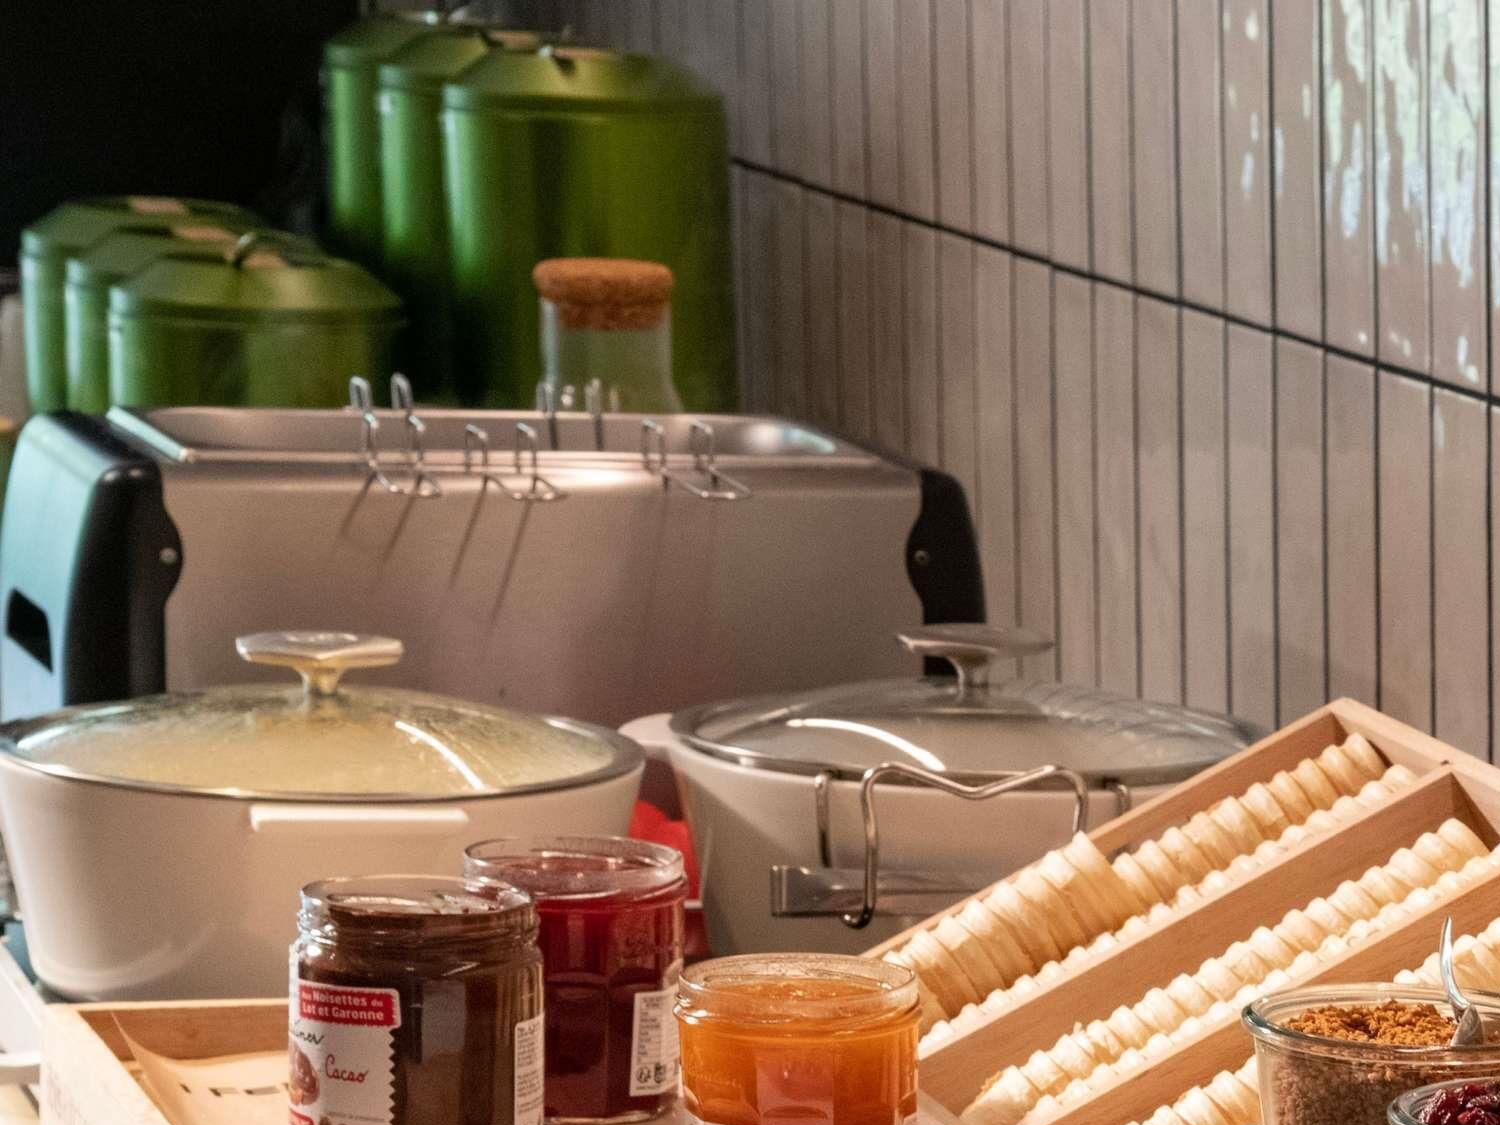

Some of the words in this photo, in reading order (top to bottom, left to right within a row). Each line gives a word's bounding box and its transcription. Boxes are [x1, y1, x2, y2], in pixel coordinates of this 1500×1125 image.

[313, 990, 367, 1007] Noisettes
[318, 1005, 329, 1016] et
[331, 1006, 384, 1021] Garonne
[325, 1054, 368, 1083] Cacao
